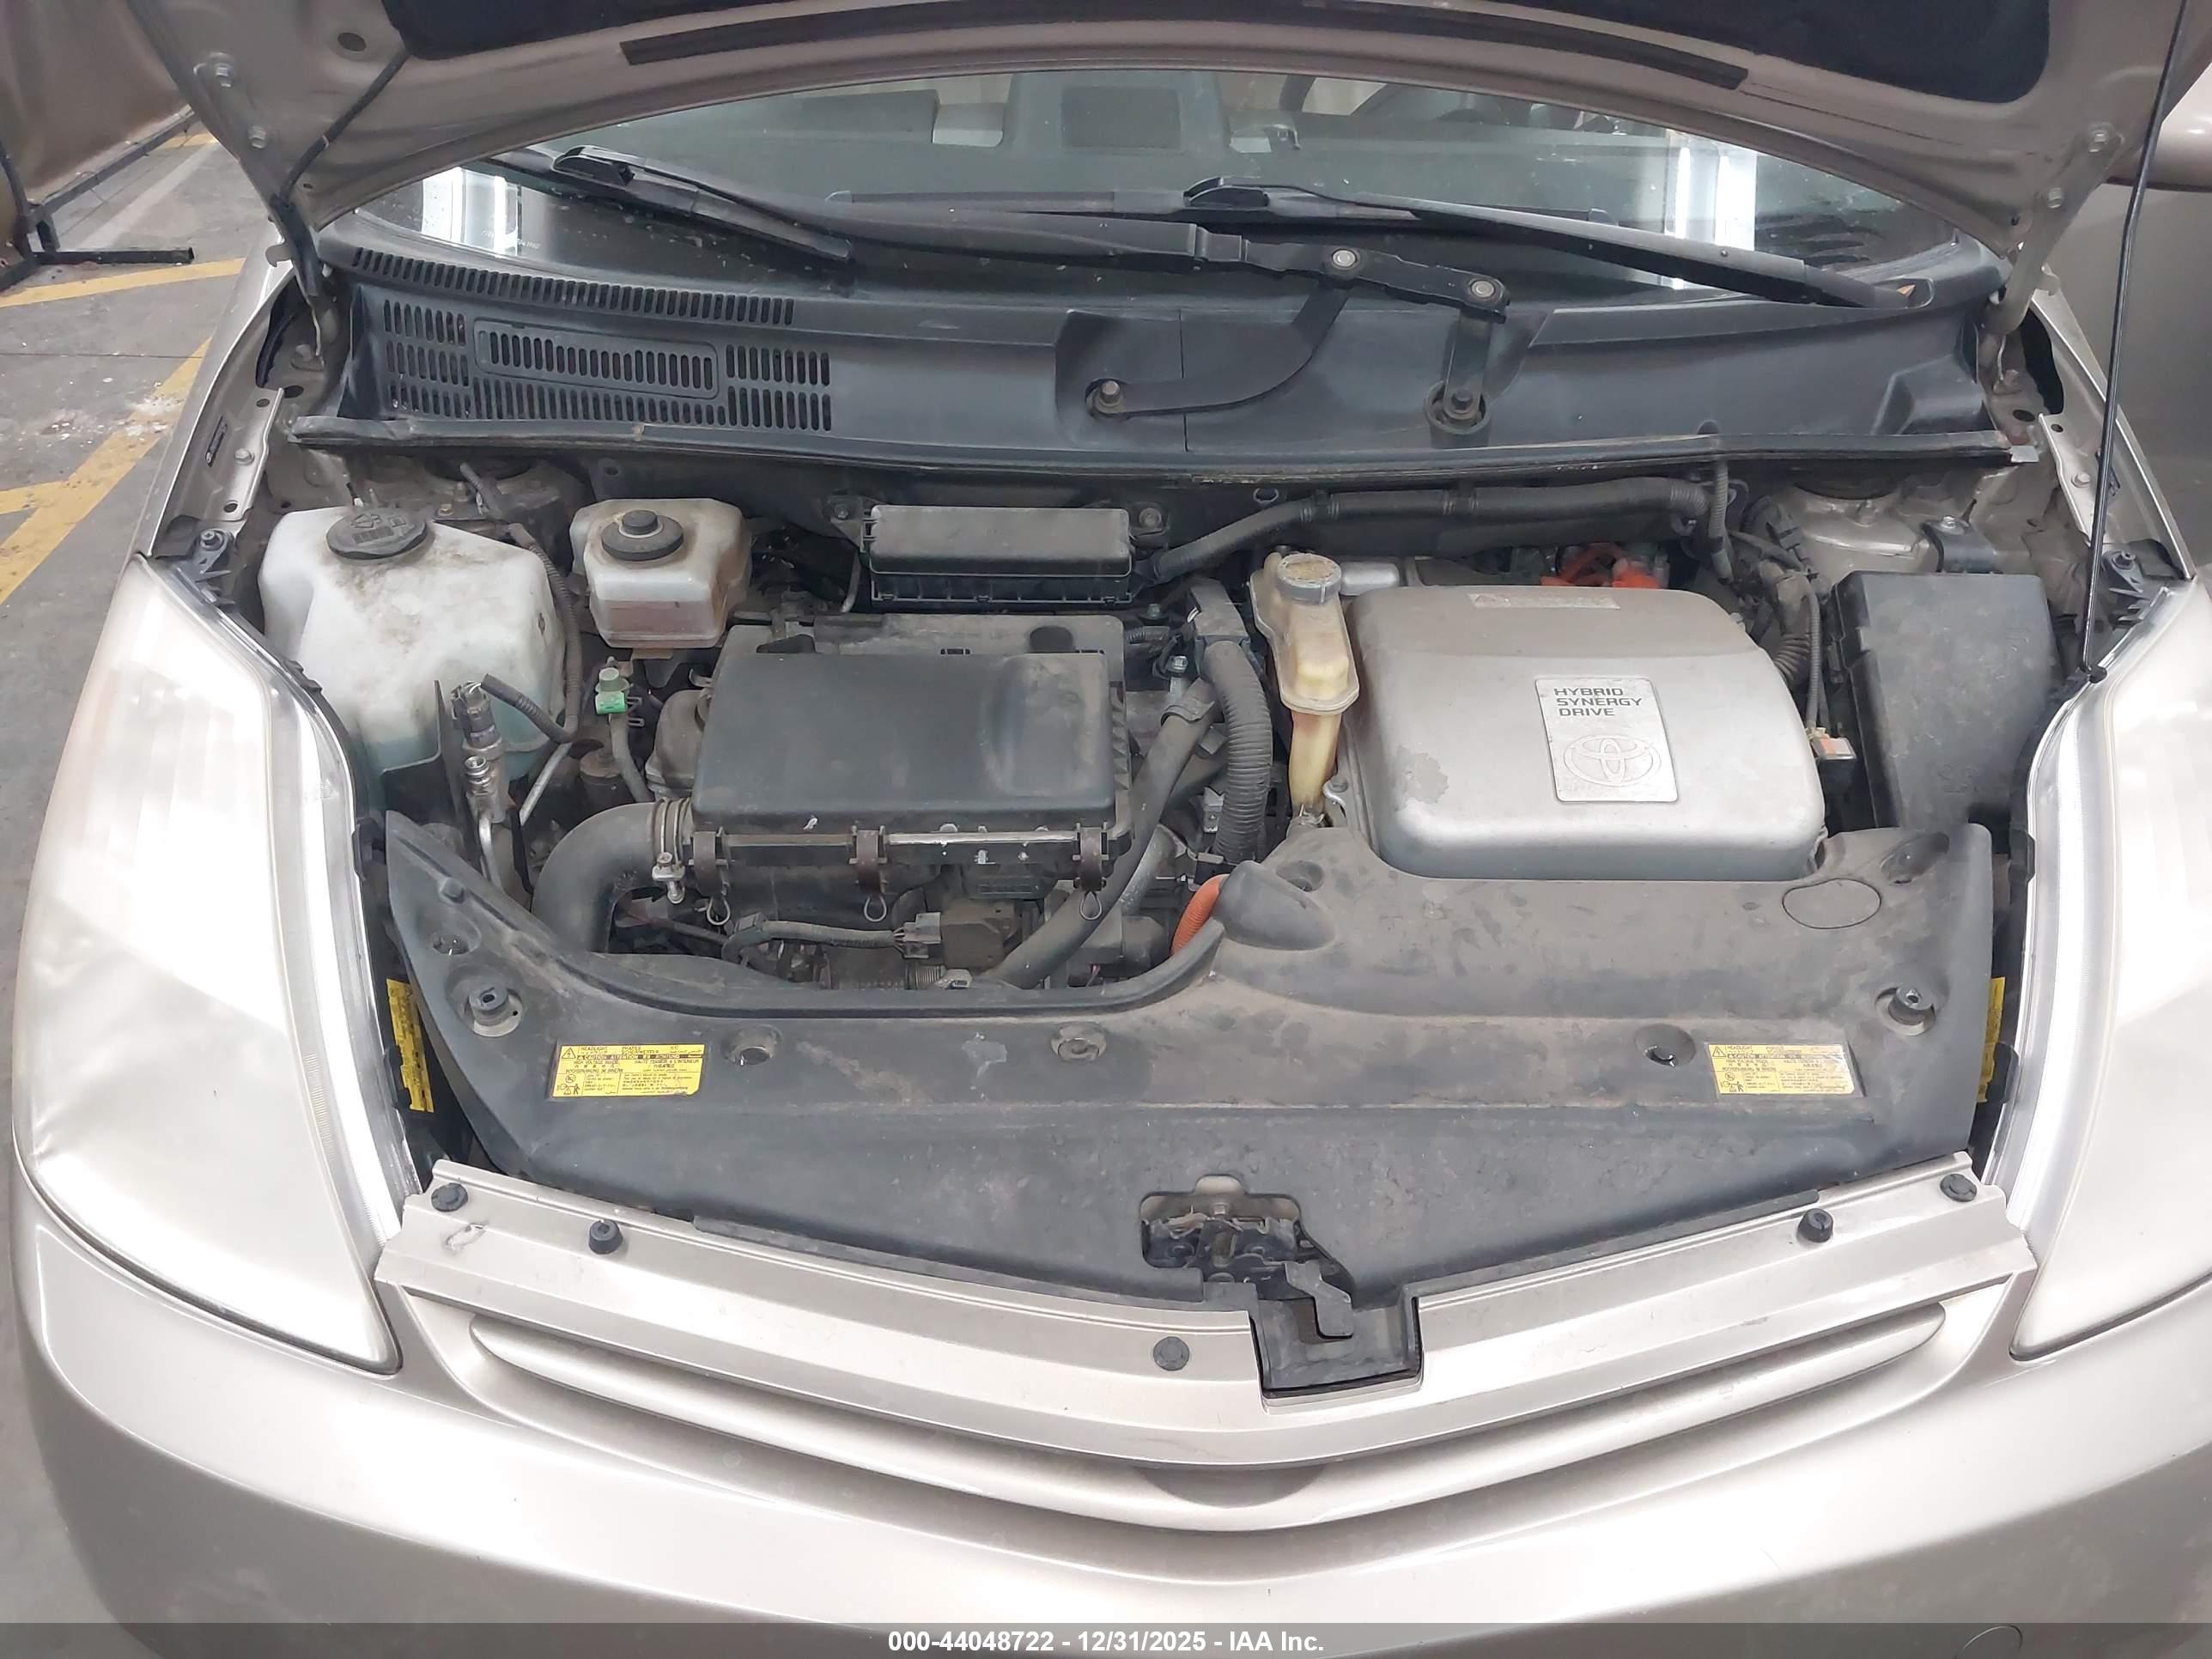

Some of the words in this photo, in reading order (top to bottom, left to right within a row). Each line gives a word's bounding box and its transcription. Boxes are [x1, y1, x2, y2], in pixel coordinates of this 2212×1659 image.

[1553, 687, 1624, 696] HYBRID
[1555, 697, 1643, 707] SYNERGY
[1559, 708, 1616, 717] DRIVE
